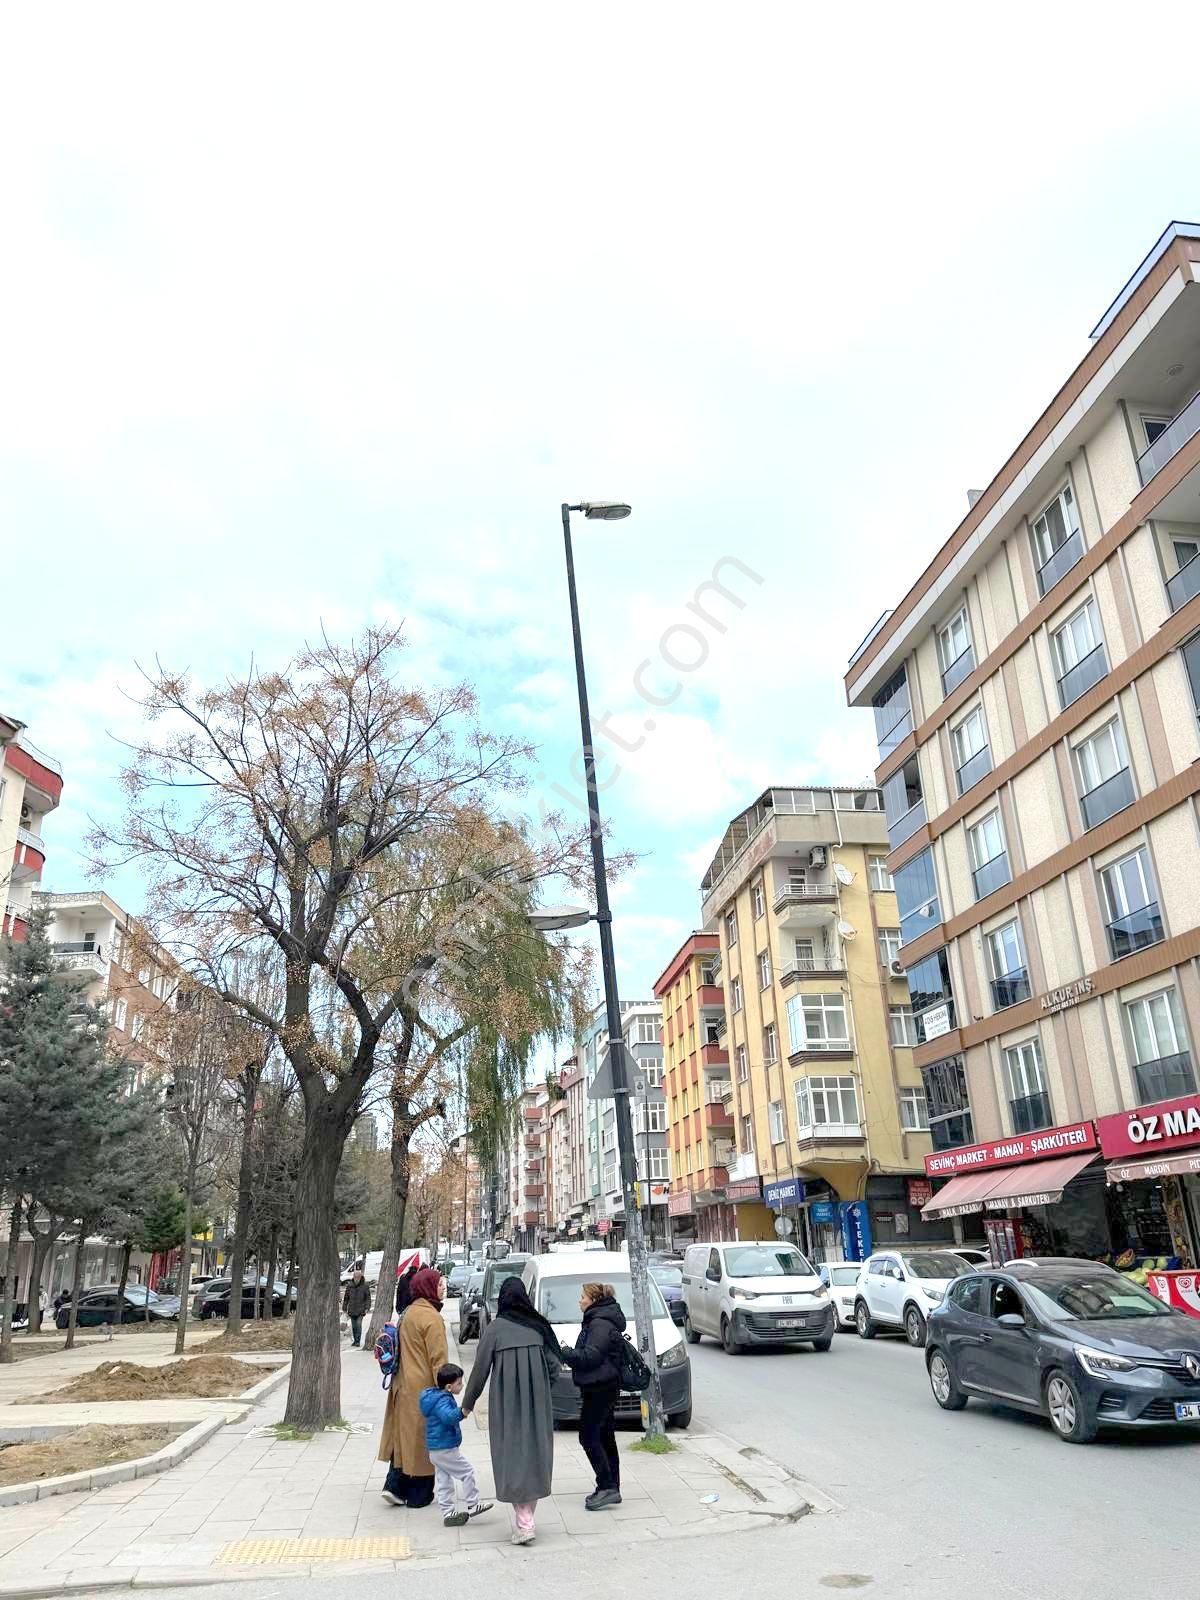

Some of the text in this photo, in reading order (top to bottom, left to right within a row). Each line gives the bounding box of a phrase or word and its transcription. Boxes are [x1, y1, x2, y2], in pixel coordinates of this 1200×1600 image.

[1040, 987, 1073, 1010] ALKUR
[1127, 1114, 1162, 1143] ÖZ
[930, 1156, 956, 1170] SEVİNÇ
[956, 1149, 987, 1166] MARKET
[994, 1142, 1024, 1159] MANAV
[1031, 1126, 1087, 1155] ŞARKÜTERİ
[1120, 1168, 1130, 1178] ÖZ
[1143, 1163, 1170, 1175] MARDİN
[767, 1186, 780, 1202] DENİZ
[779, 1184, 796, 1199] MARKET
[1182, 1406, 1193, 1417] 34
